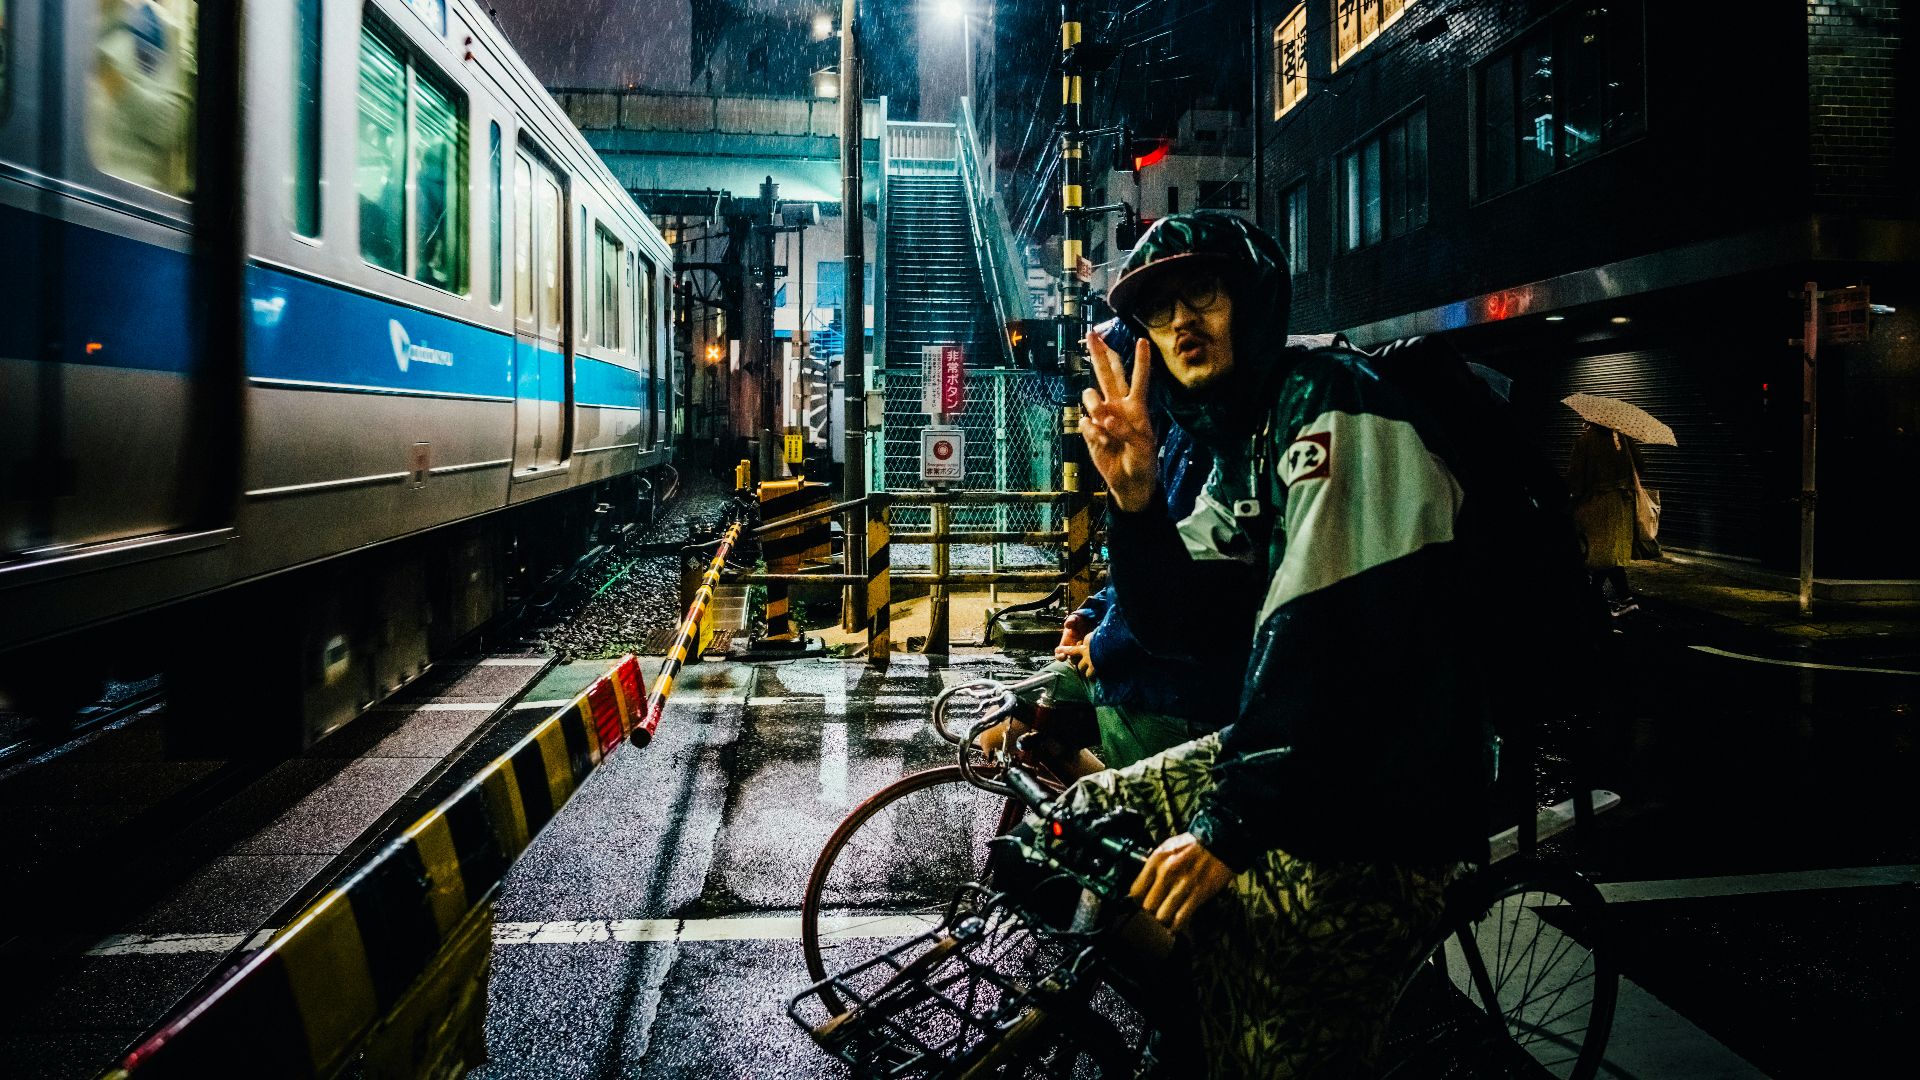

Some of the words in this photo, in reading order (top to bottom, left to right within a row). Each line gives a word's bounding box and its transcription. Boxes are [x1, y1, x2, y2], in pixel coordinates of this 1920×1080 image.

[946, 350, 959, 409] 非常ボタン
[926, 467, 959, 475] 非常ボタン
